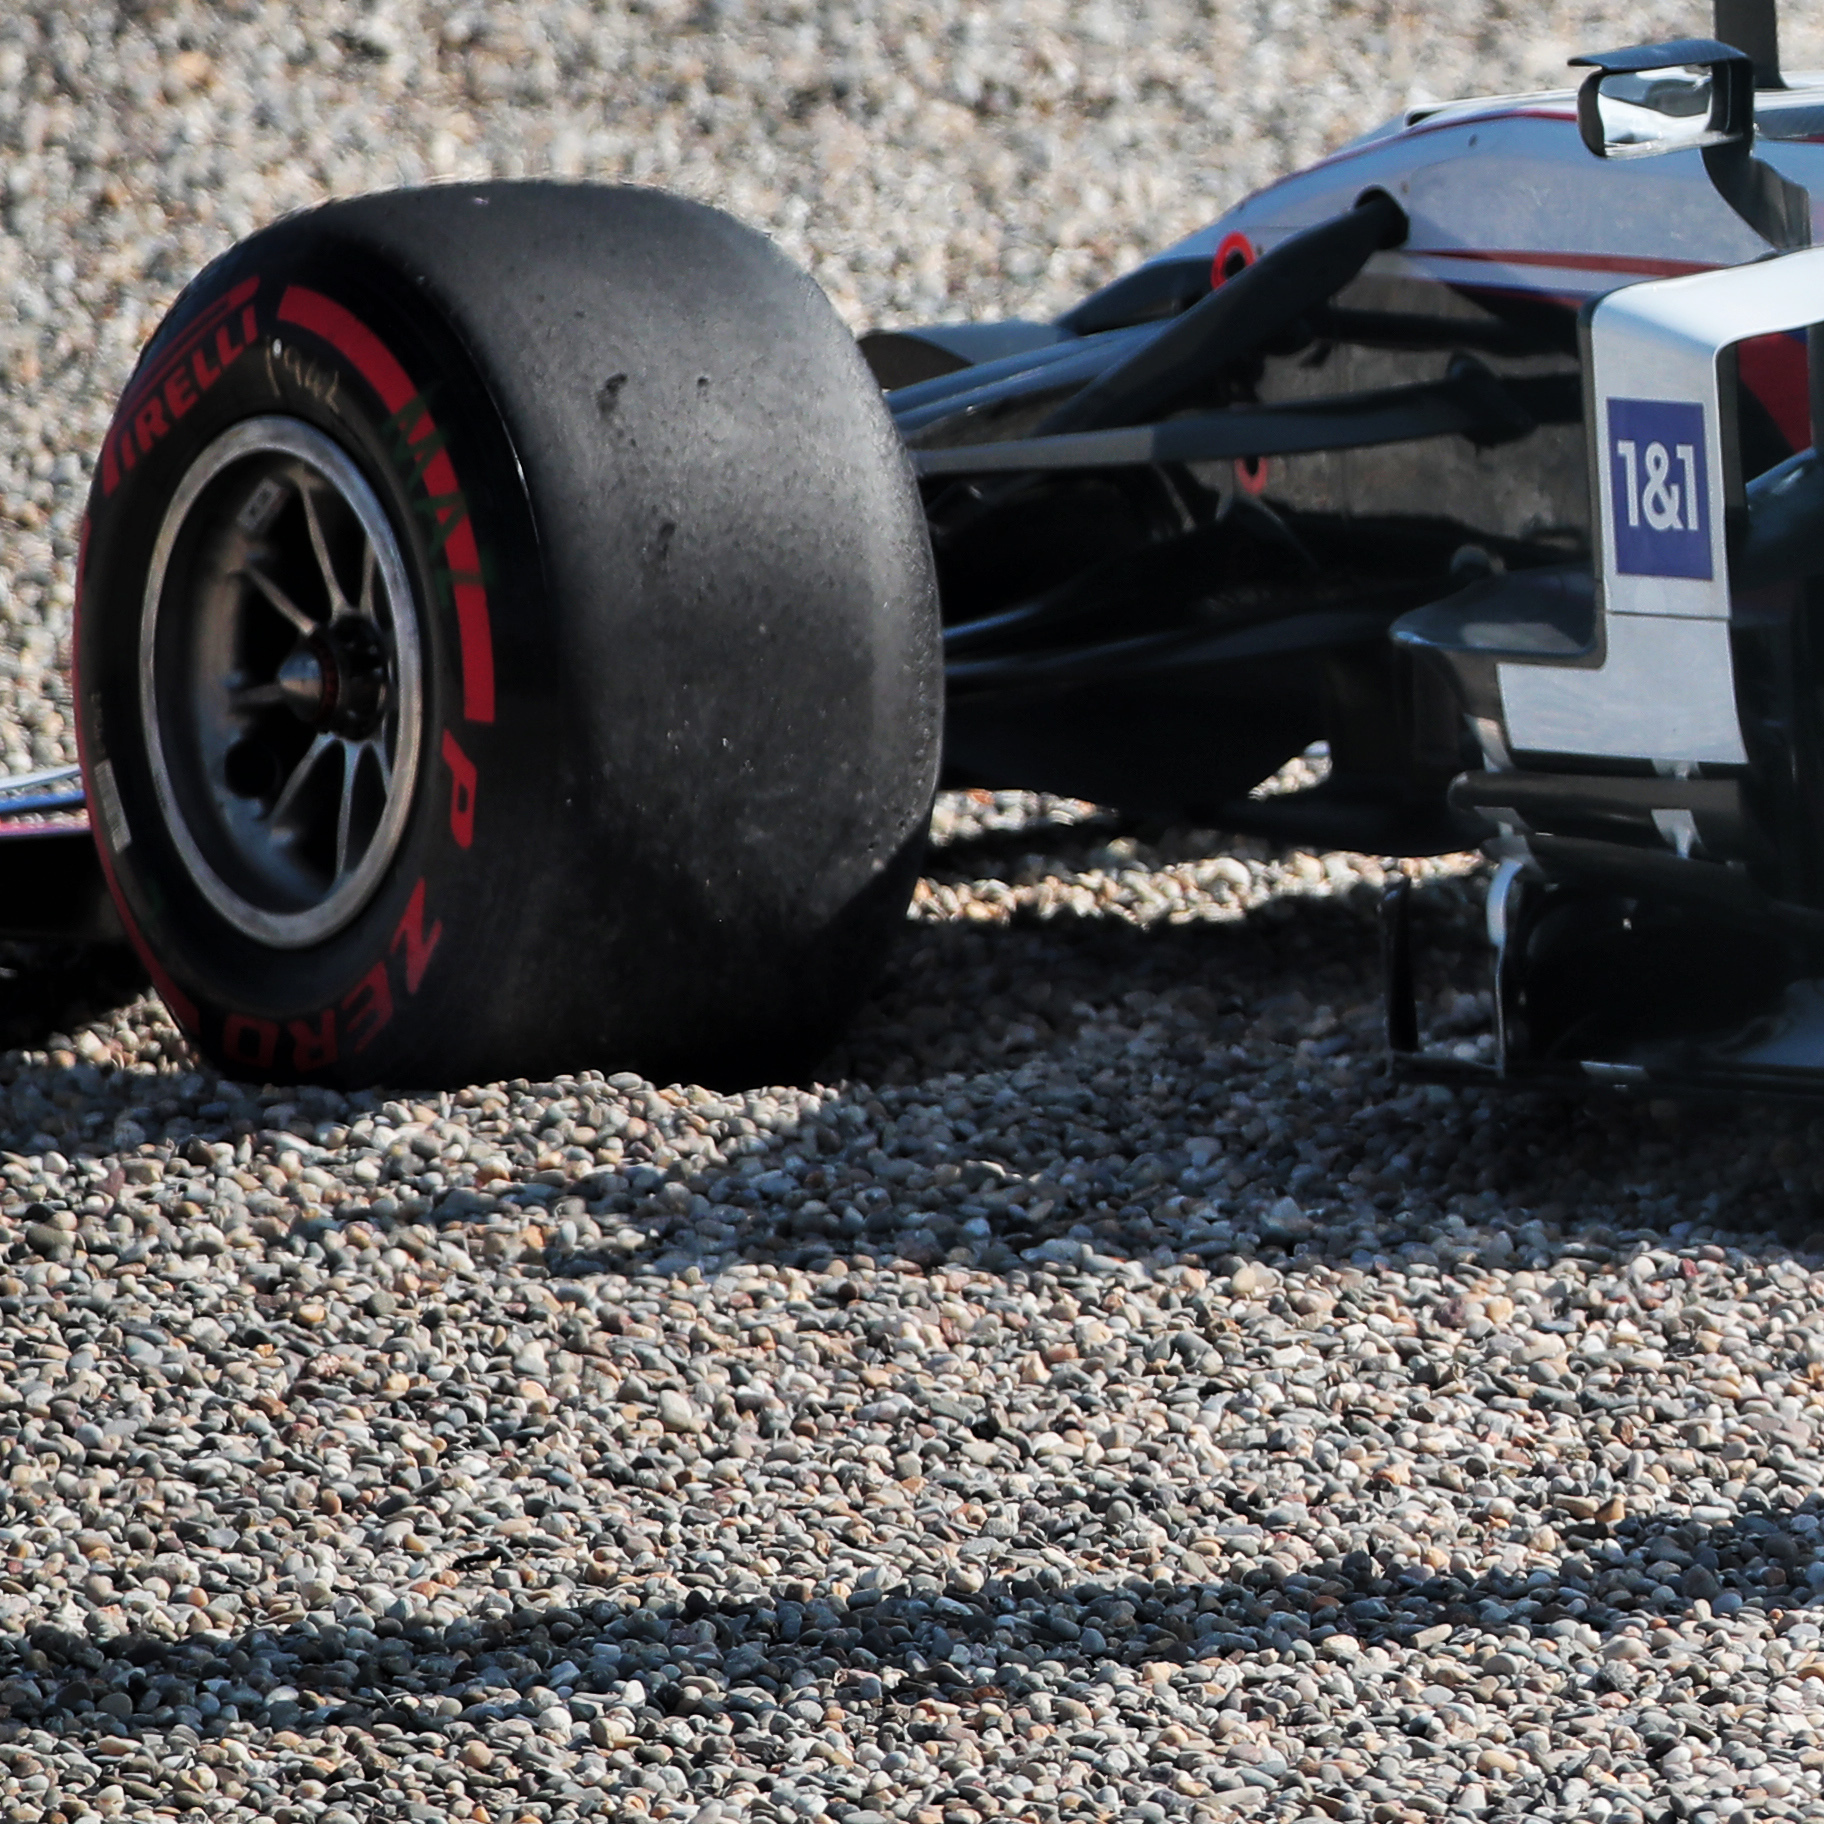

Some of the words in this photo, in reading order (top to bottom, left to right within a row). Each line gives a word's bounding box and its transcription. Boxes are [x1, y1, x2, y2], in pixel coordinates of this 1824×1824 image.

[102, 276, 260, 498] PIRELLI
[1616, 440, 1699, 532] 1&1
[441, 728, 478, 850] P
[224, 876, 443, 1073] ZERO
